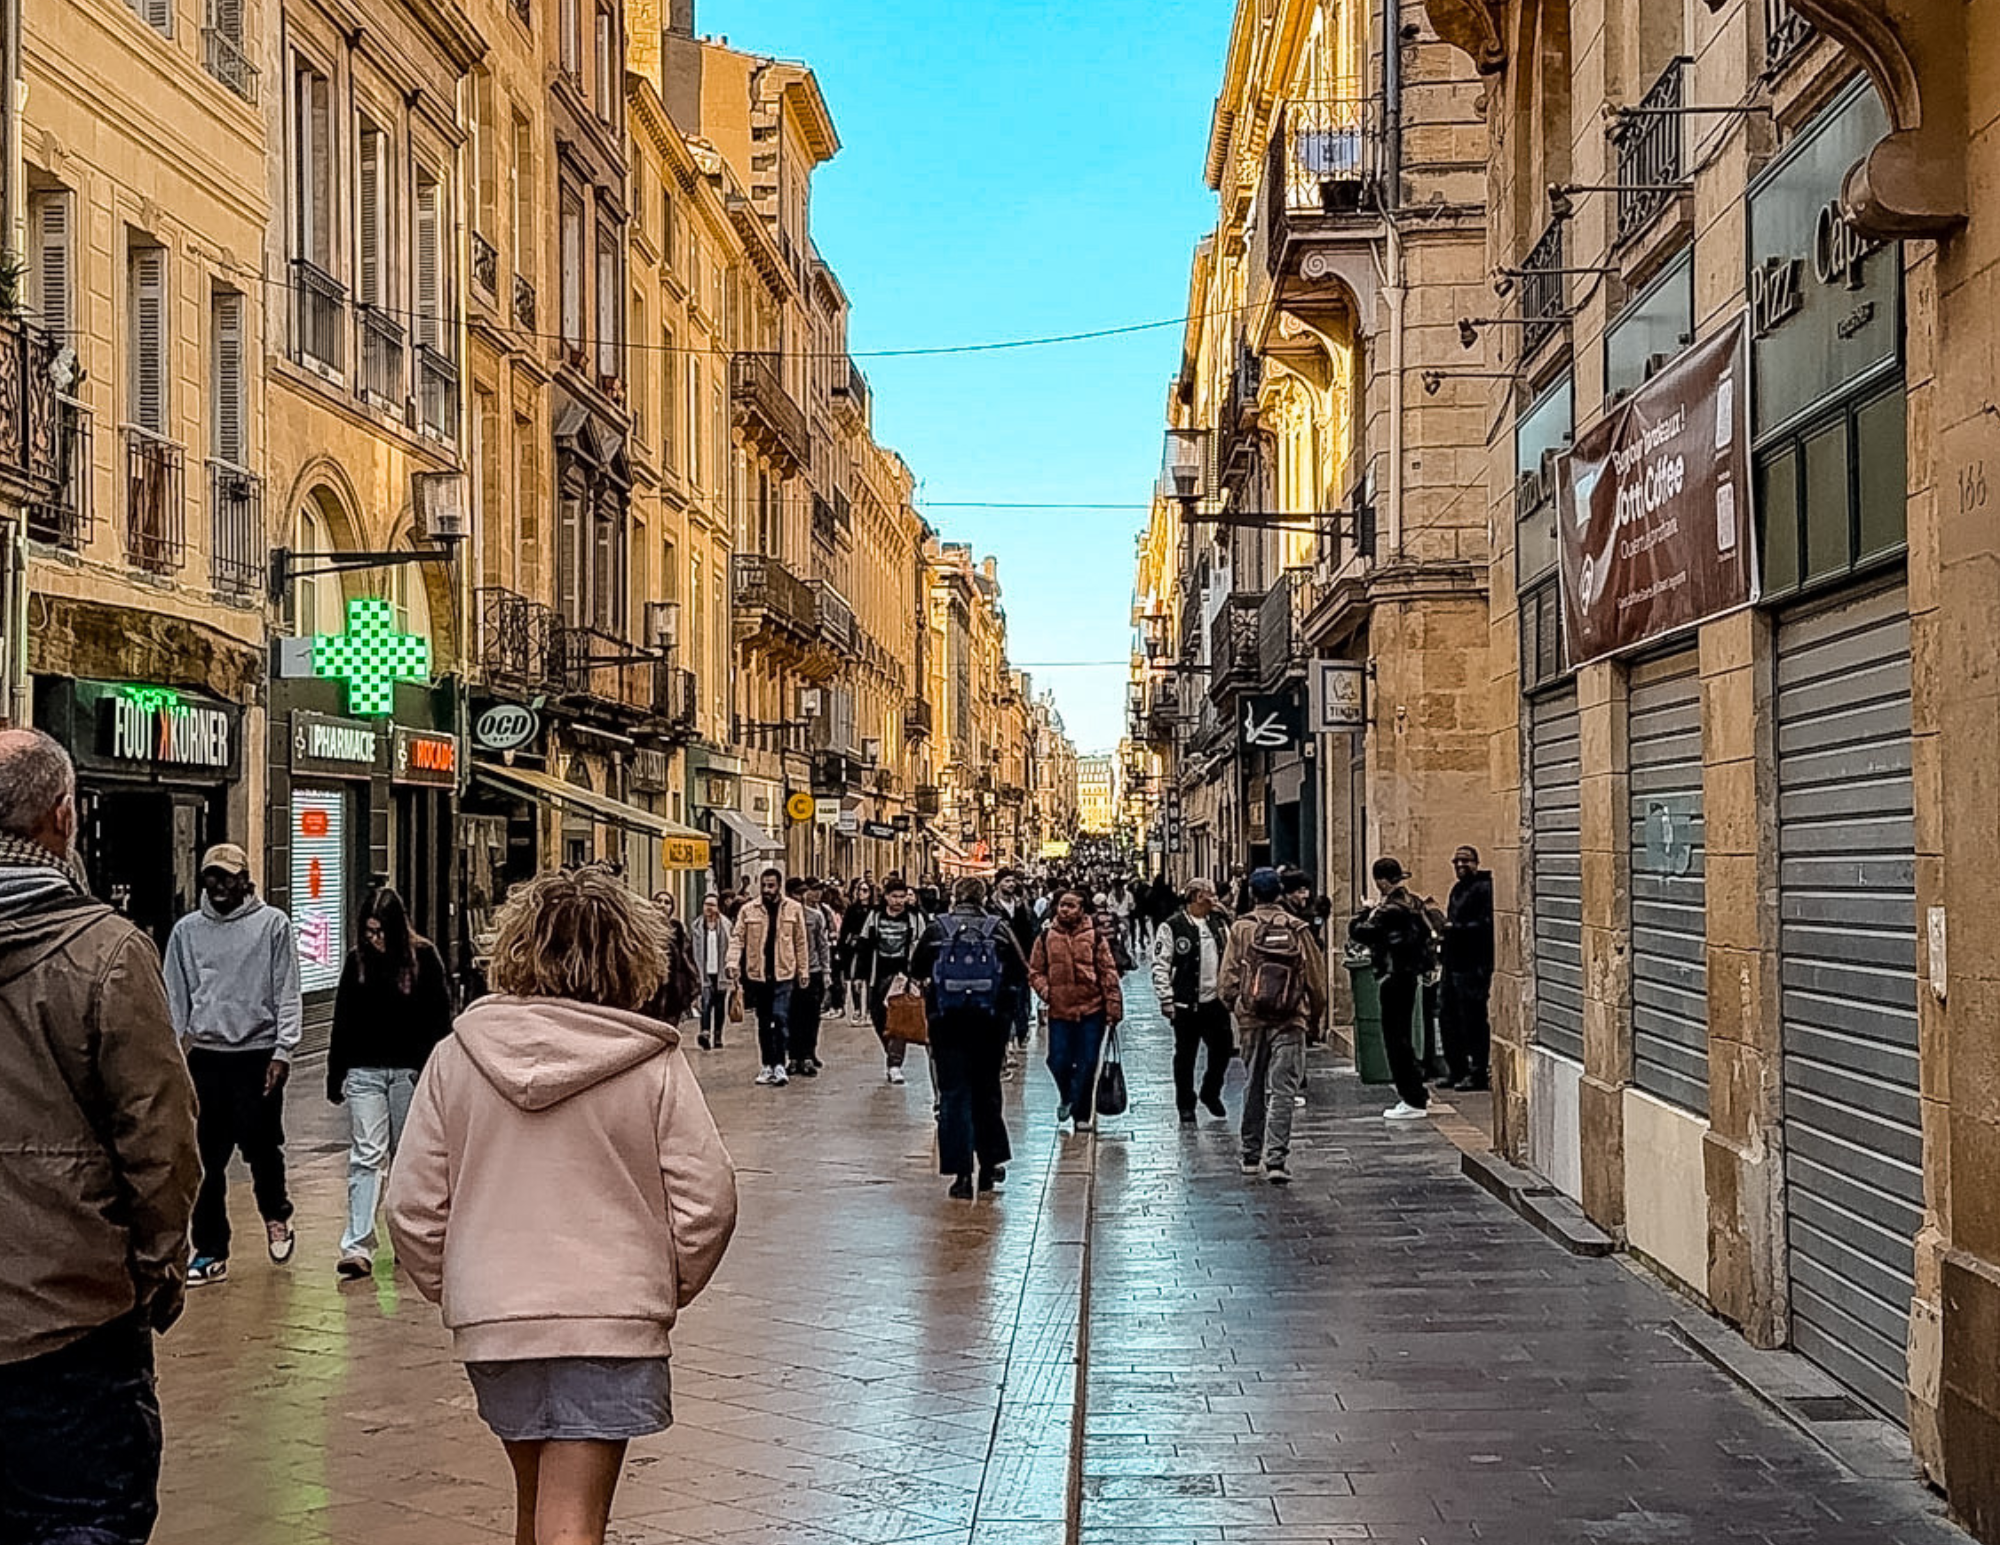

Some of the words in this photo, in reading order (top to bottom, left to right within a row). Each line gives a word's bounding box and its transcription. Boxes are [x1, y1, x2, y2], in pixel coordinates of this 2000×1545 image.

[1645, 454, 1685, 512] Coffee
[114, 697, 155, 760] FOOT
[313, 724, 376, 762] PHARMACIE
[480, 715, 528, 736] OCD
